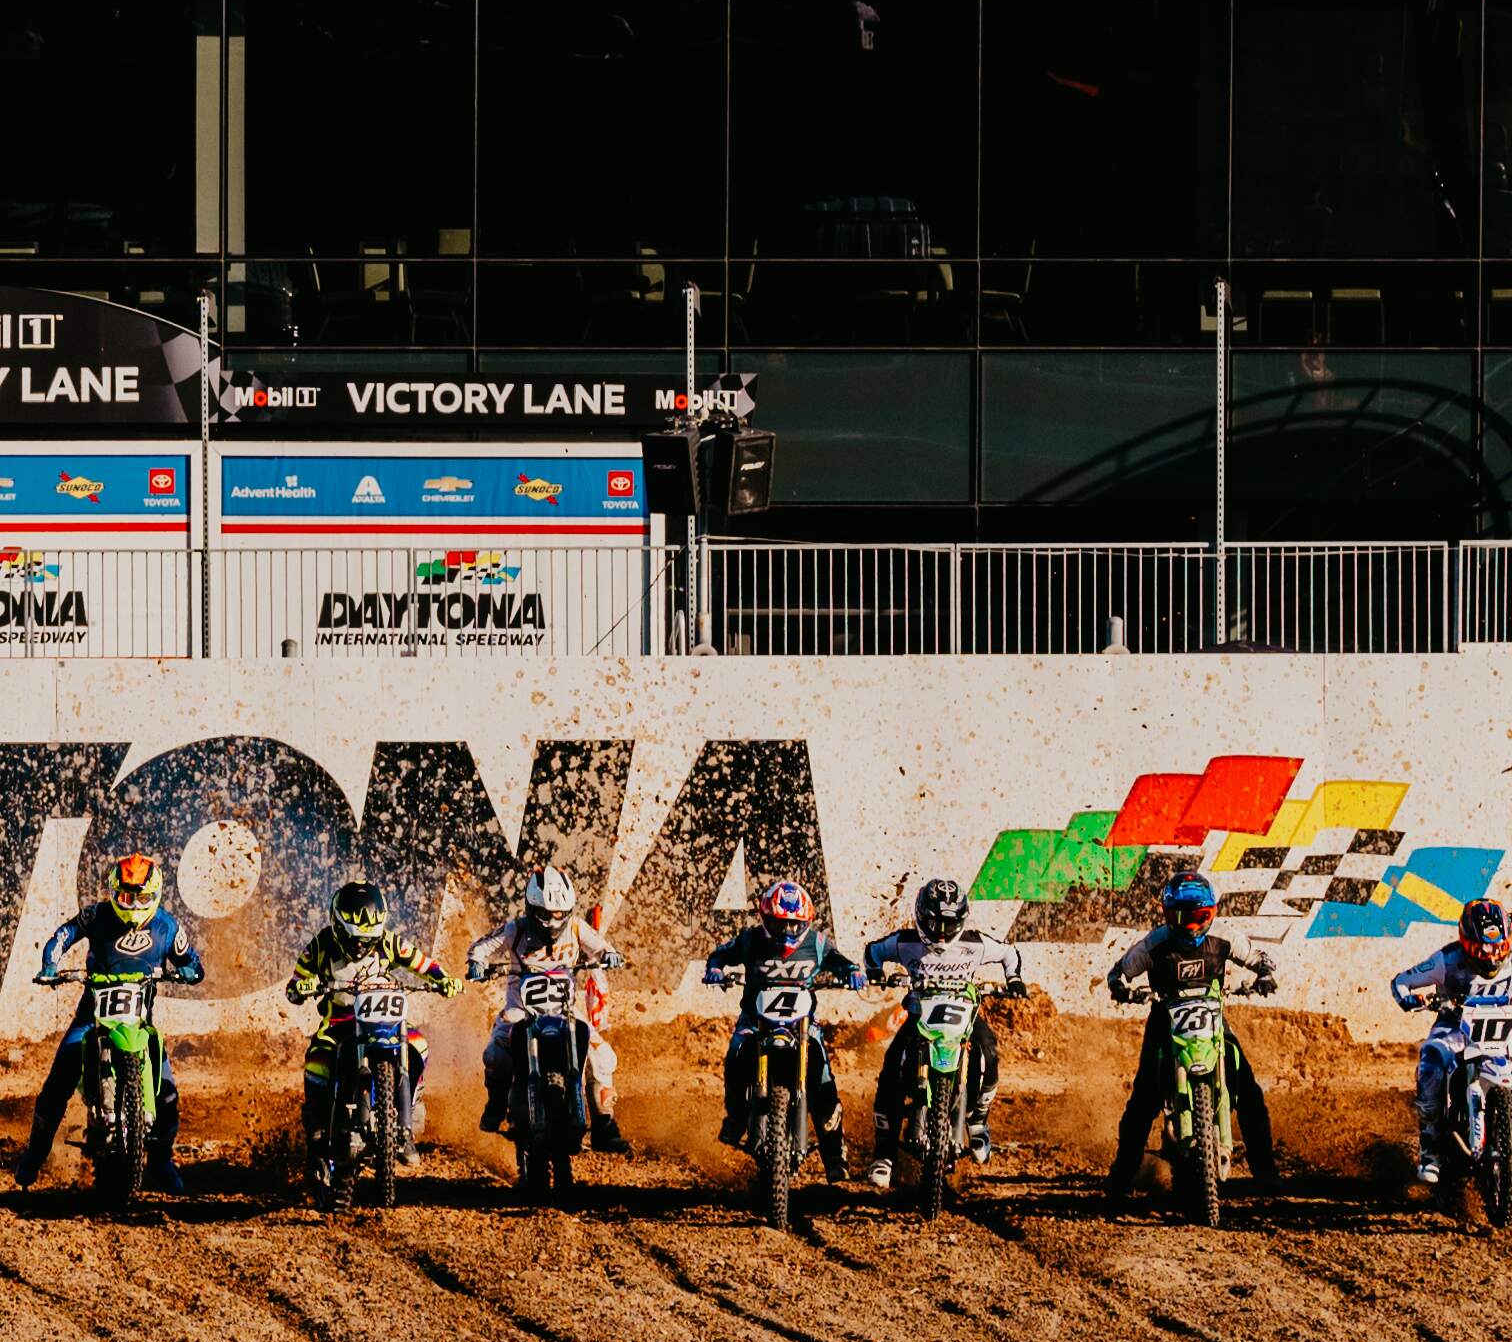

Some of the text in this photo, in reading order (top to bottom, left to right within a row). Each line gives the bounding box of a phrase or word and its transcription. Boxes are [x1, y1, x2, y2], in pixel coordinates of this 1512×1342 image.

[26, 317, 48, 346] 1
[21, 367, 139, 403] LANE
[234, 387, 312, 407] Mobil 1
[347, 383, 626, 415] VICTORY LANE
[59, 482, 101, 492] SUNOCO
[231, 486, 316, 498] AdventHealth
[517, 484, 561, 495] SUNOCO
[144, 498, 181, 507] TOYOTA
[602, 501, 639, 509] TOYOTA
[317, 593, 546, 629] DAYTONA
[314, 633, 545, 646] INTERNATIONAL SPEEDWAY
[525, 976, 570, 1005] 23
[99, 990, 143, 1018] 181
[357, 996, 405, 1017] 449
[764, 992, 799, 1018] 4
[926, 1004, 966, 1026] 6
